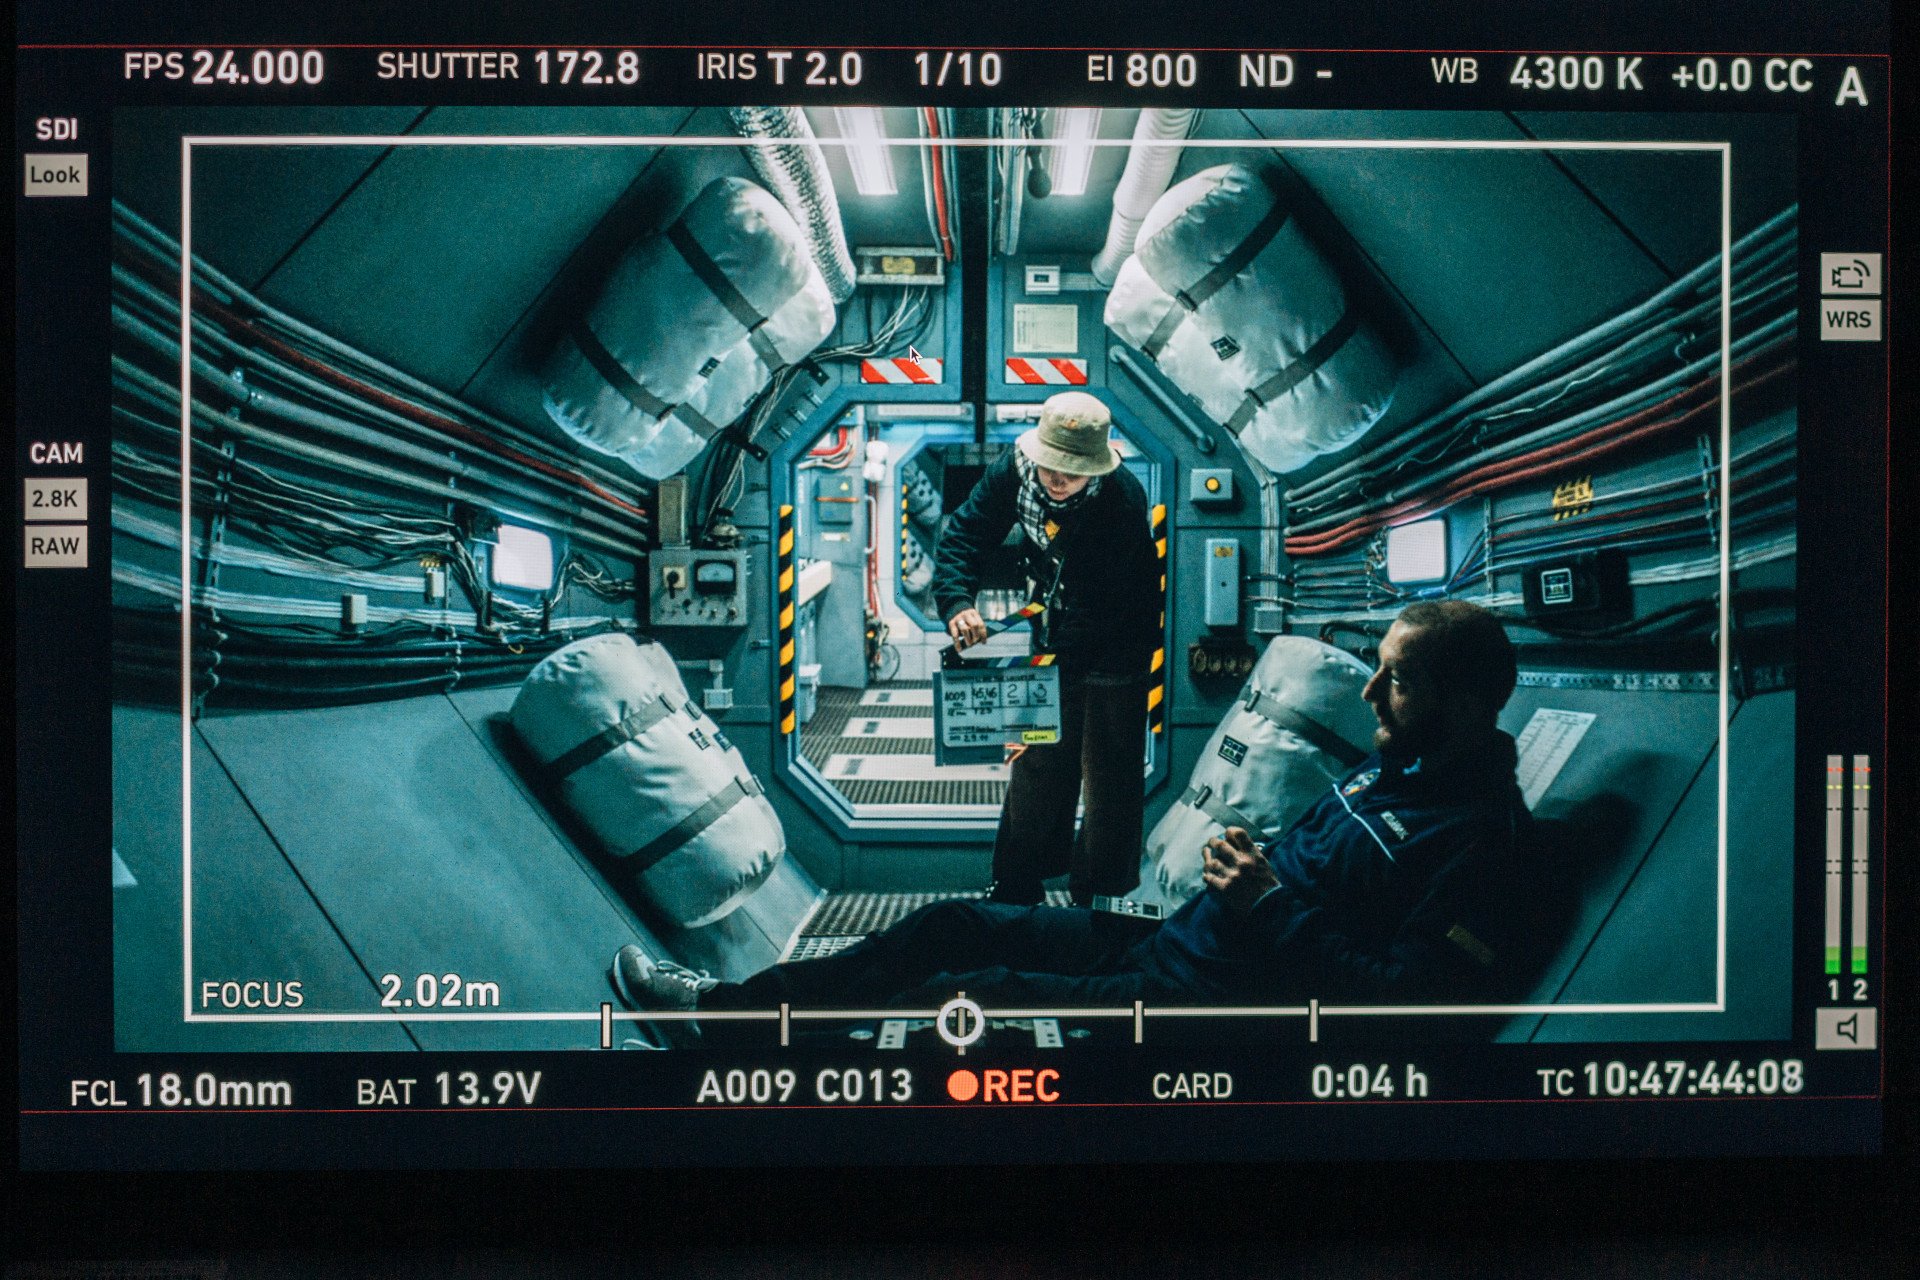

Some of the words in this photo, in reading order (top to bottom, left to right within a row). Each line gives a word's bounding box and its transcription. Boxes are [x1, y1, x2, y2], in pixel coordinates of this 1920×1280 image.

[124, 52, 185, 80] FPS
[191, 49, 324, 85] 24.000
[377, 52, 519, 79] SHUTTER
[535, 50, 640, 85] 172.8
[697, 53, 757, 80] IRIS
[766, 51, 793, 86] T
[805, 51, 863, 86] 2.0
[914, 52, 1002, 87] 1/10
[1087, 55, 1114, 82] EI
[1125, 53, 1197, 88] 800
[1240, 54, 1294, 88] ND
[1430, 57, 1478, 84] WB
[1509, 56, 1604, 91] 4300
[1617, 57, 1644, 91] K
[1671, 58, 1753, 92] +0.0
[1764, 58, 1814, 93] CC
[1834, 66, 1869, 107] A
[36, 117, 78, 141] SDI
[30, 166, 81, 184] Look
[1826, 310, 1872, 329] WRS
[30, 442, 83, 465] CAM
[32, 489, 78, 508] 2.8K
[31, 537, 80, 555] RAW
[1007, 683, 1018, 699] 2
[1033, 683, 1048, 699] 3
[202, 981, 304, 1008] FOCUS
[381, 973, 500, 1007] 2.02m
[1828, 978, 1839, 1001] 1
[1853, 978, 1868, 1001] 2
[71, 1081, 128, 1107] FCL
[137, 1073, 292, 1107] 18.0mm
[357, 1079, 417, 1105] BAT
[436, 1071, 542, 1106] 13.9V
[696, 1069, 797, 1104] A009
[816, 1068, 912, 1103] C013
[983, 1069, 1060, 1103] REC
[1152, 1072, 1233, 1100] CARD
[1311, 1064, 1395, 1099] 0:04
[1405, 1064, 1428, 1098] h
[1536, 1069, 1575, 1096] TC
[1584, 1059, 1804, 1095] 10:47:44:08
